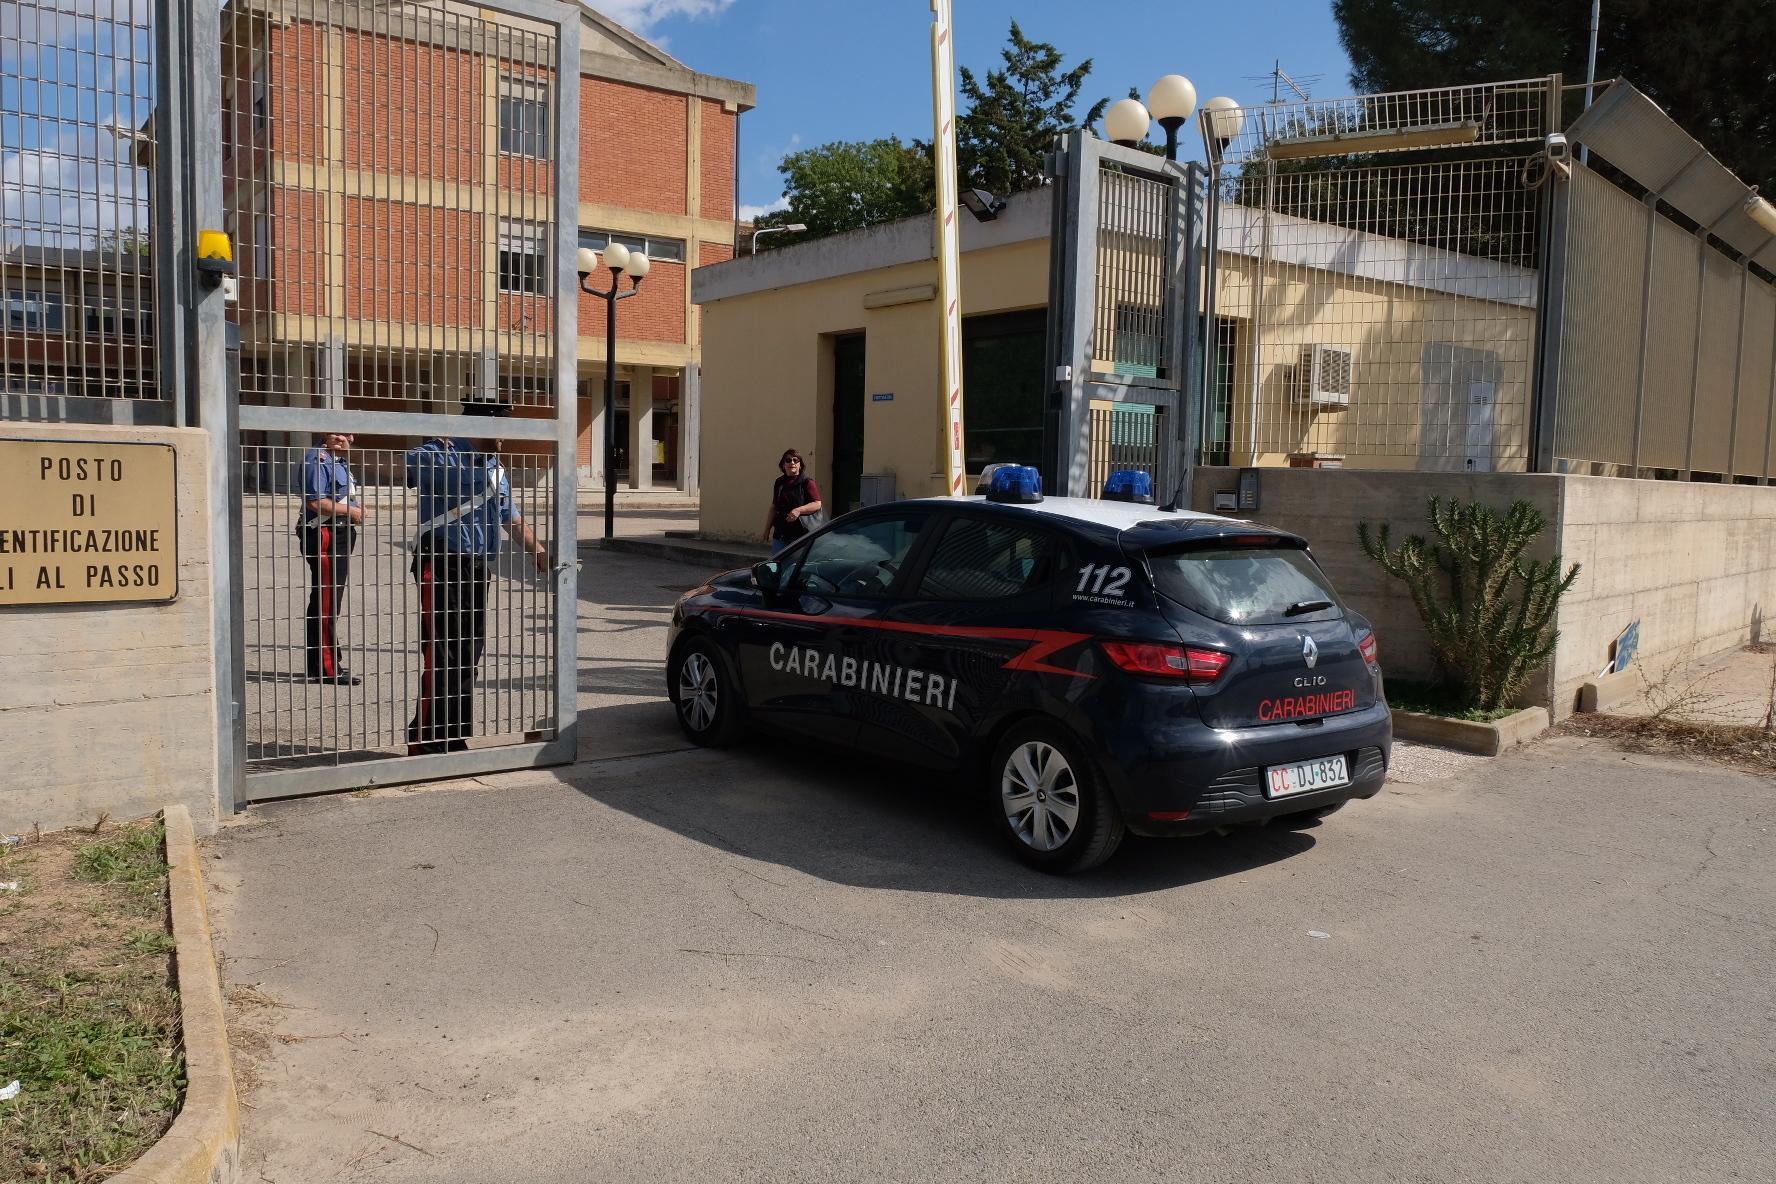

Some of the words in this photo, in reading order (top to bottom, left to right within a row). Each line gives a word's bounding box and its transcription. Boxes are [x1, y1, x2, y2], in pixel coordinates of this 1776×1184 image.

[40, 457, 122, 481] POSTO
[72, 494, 95, 516] DI
[0, 529, 159, 553] ENTIFICAZIONE
[36, 566, 65, 589] AL
[86, 564, 159, 588] PASSO
[1076, 563, 1132, 596] 112
[1072, 594, 1135, 608] www.carabinieri.it
[769, 641, 958, 711] CARABINIERI
[1293, 675, 1327, 688] CLIO
[1258, 690, 1356, 721] CARABINIERI
[1271, 767, 1290, 792] CC
